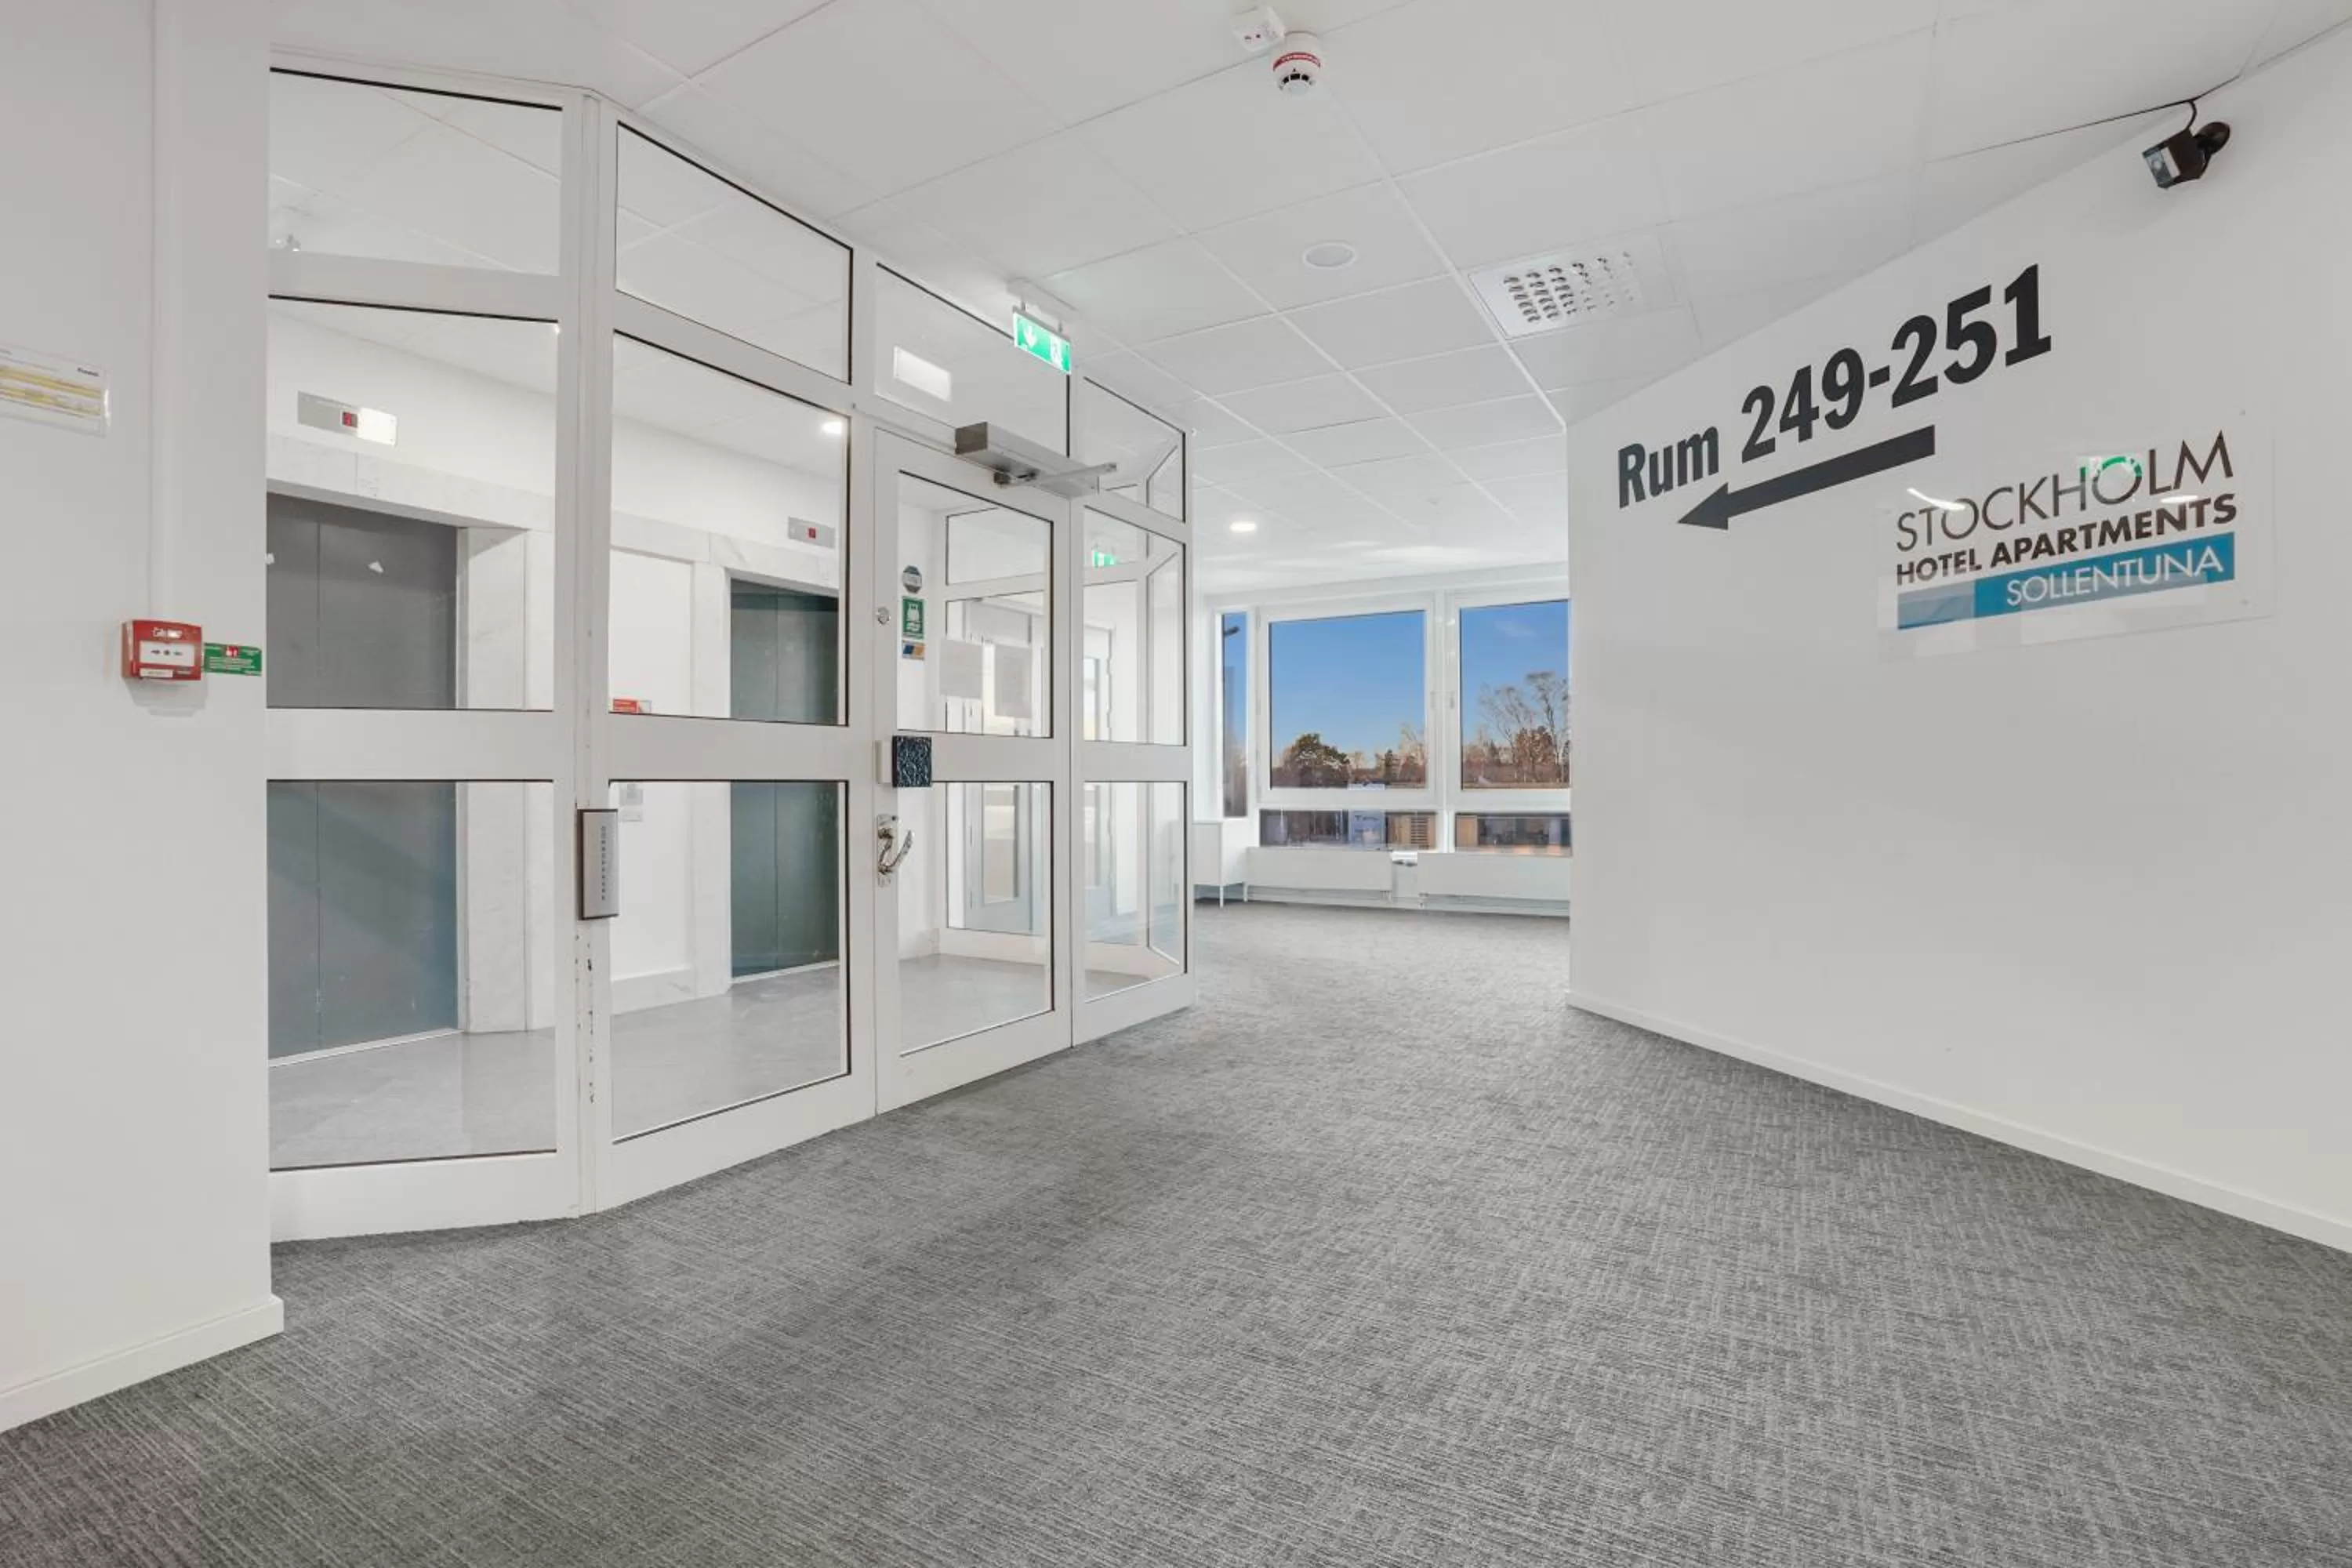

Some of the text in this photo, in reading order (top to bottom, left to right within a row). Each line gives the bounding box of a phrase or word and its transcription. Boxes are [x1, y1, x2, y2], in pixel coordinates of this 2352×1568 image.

[1618, 263, 2052, 509] Rum 249-251
[1896, 430, 2234, 552] STOCKHOLM
[1896, 493, 2238, 586] HOTEL APARTMENTS
[2006, 545, 2224, 606] SOLLENTUNA
